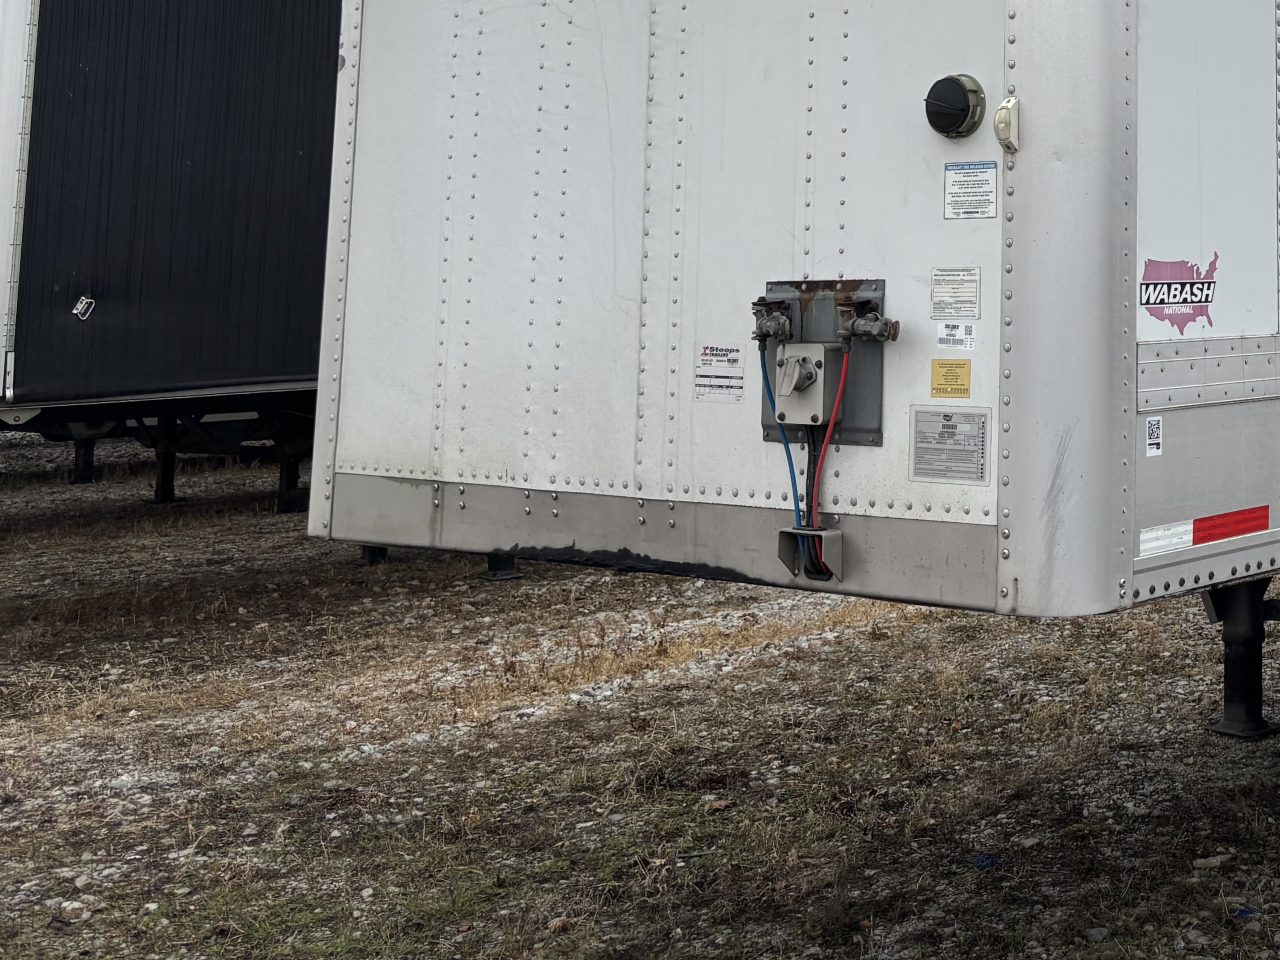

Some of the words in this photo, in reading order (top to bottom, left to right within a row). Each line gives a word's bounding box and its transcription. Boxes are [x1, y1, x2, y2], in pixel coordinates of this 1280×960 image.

[1141, 283, 1215, 304] WABASH
[1164, 305, 1194, 314] NATIONAL
[709, 346, 740, 354] Stoops
